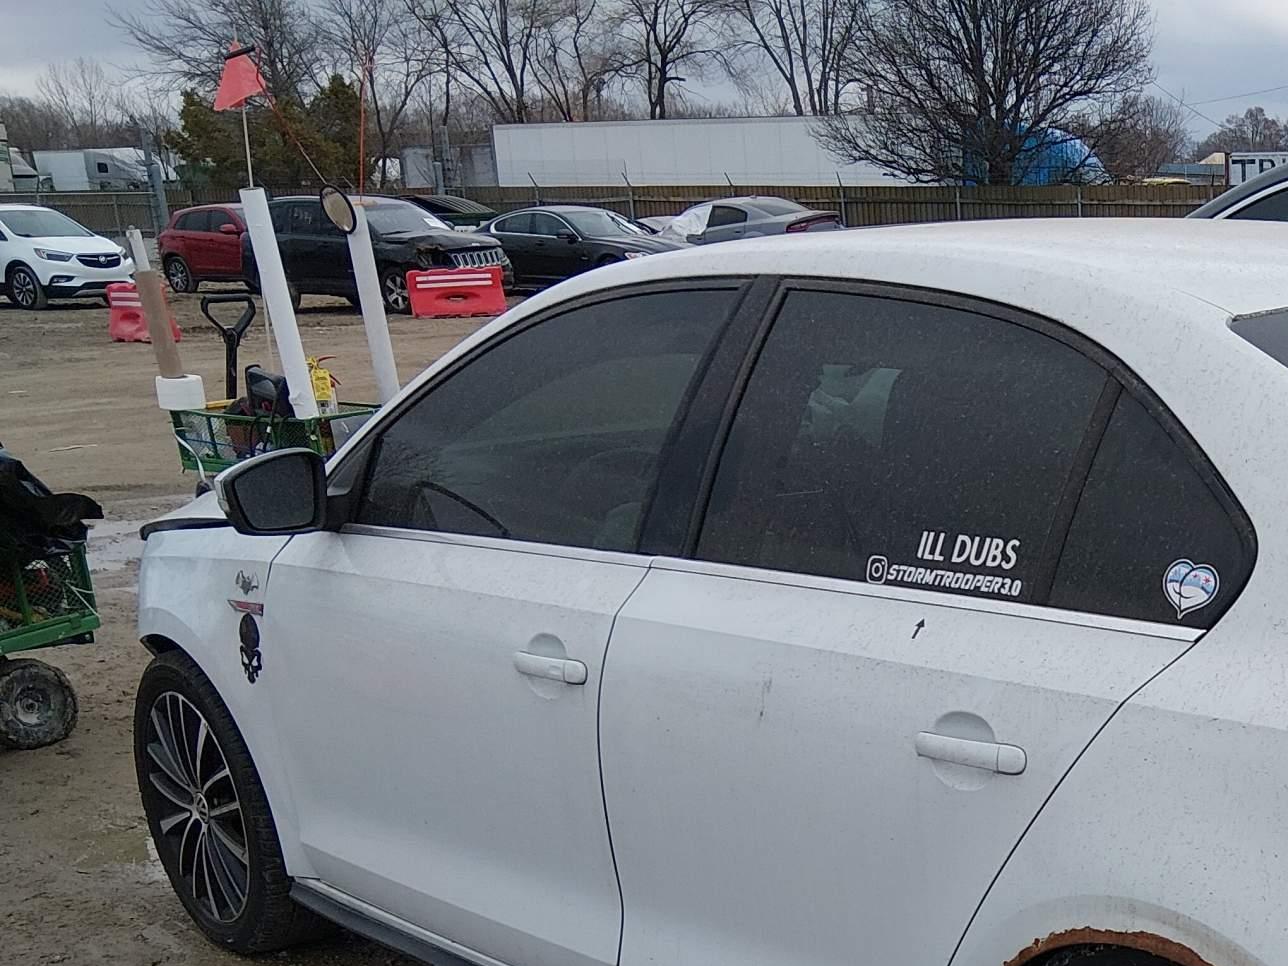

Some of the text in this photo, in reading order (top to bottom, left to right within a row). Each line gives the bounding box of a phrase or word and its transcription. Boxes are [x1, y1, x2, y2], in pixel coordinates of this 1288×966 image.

[917, 531, 1020, 570] ILL DUBS
[887, 565, 1022, 597] STORMTROOPER3.0
